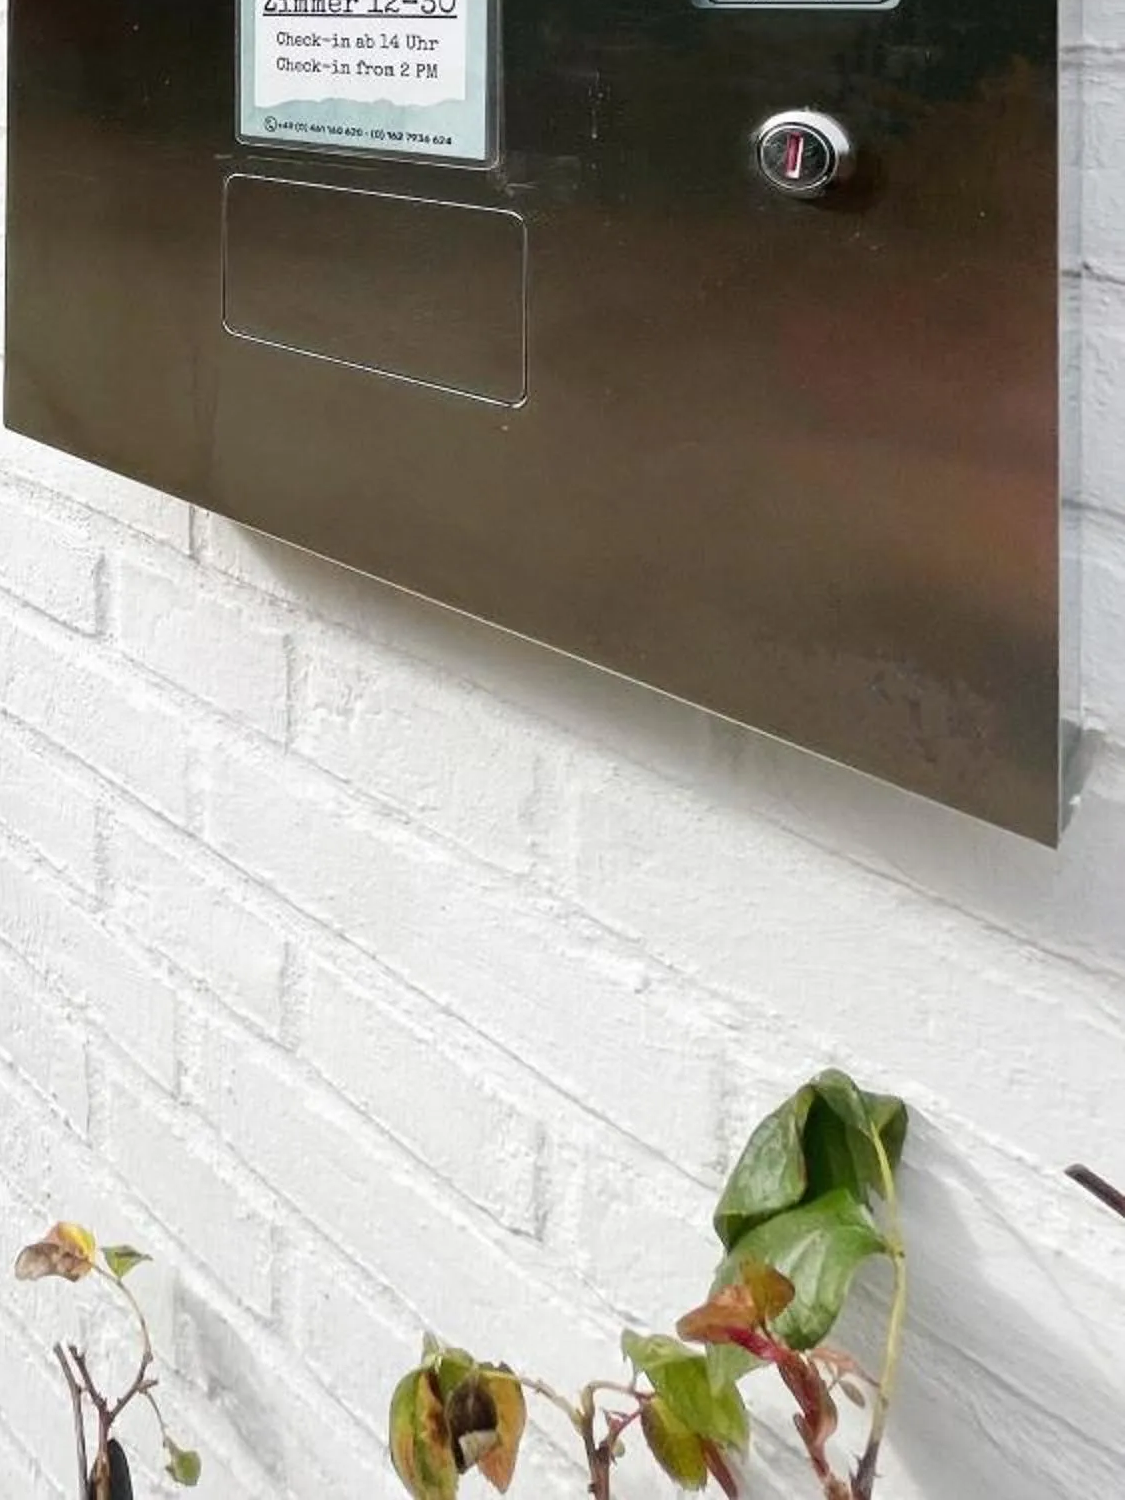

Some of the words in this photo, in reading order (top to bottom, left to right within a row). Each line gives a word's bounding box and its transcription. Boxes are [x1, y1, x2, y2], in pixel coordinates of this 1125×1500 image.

[276, 32, 351, 49] Check-in
[357, 33, 375, 49] ab
[380, 33, 400, 50] 14
[406, 34, 439, 51] Uhr
[276, 57, 351, 75] Check-in
[357, 59, 395, 77] from
[400, 63, 410, 77] 2
[416, 62, 438, 79] PM
